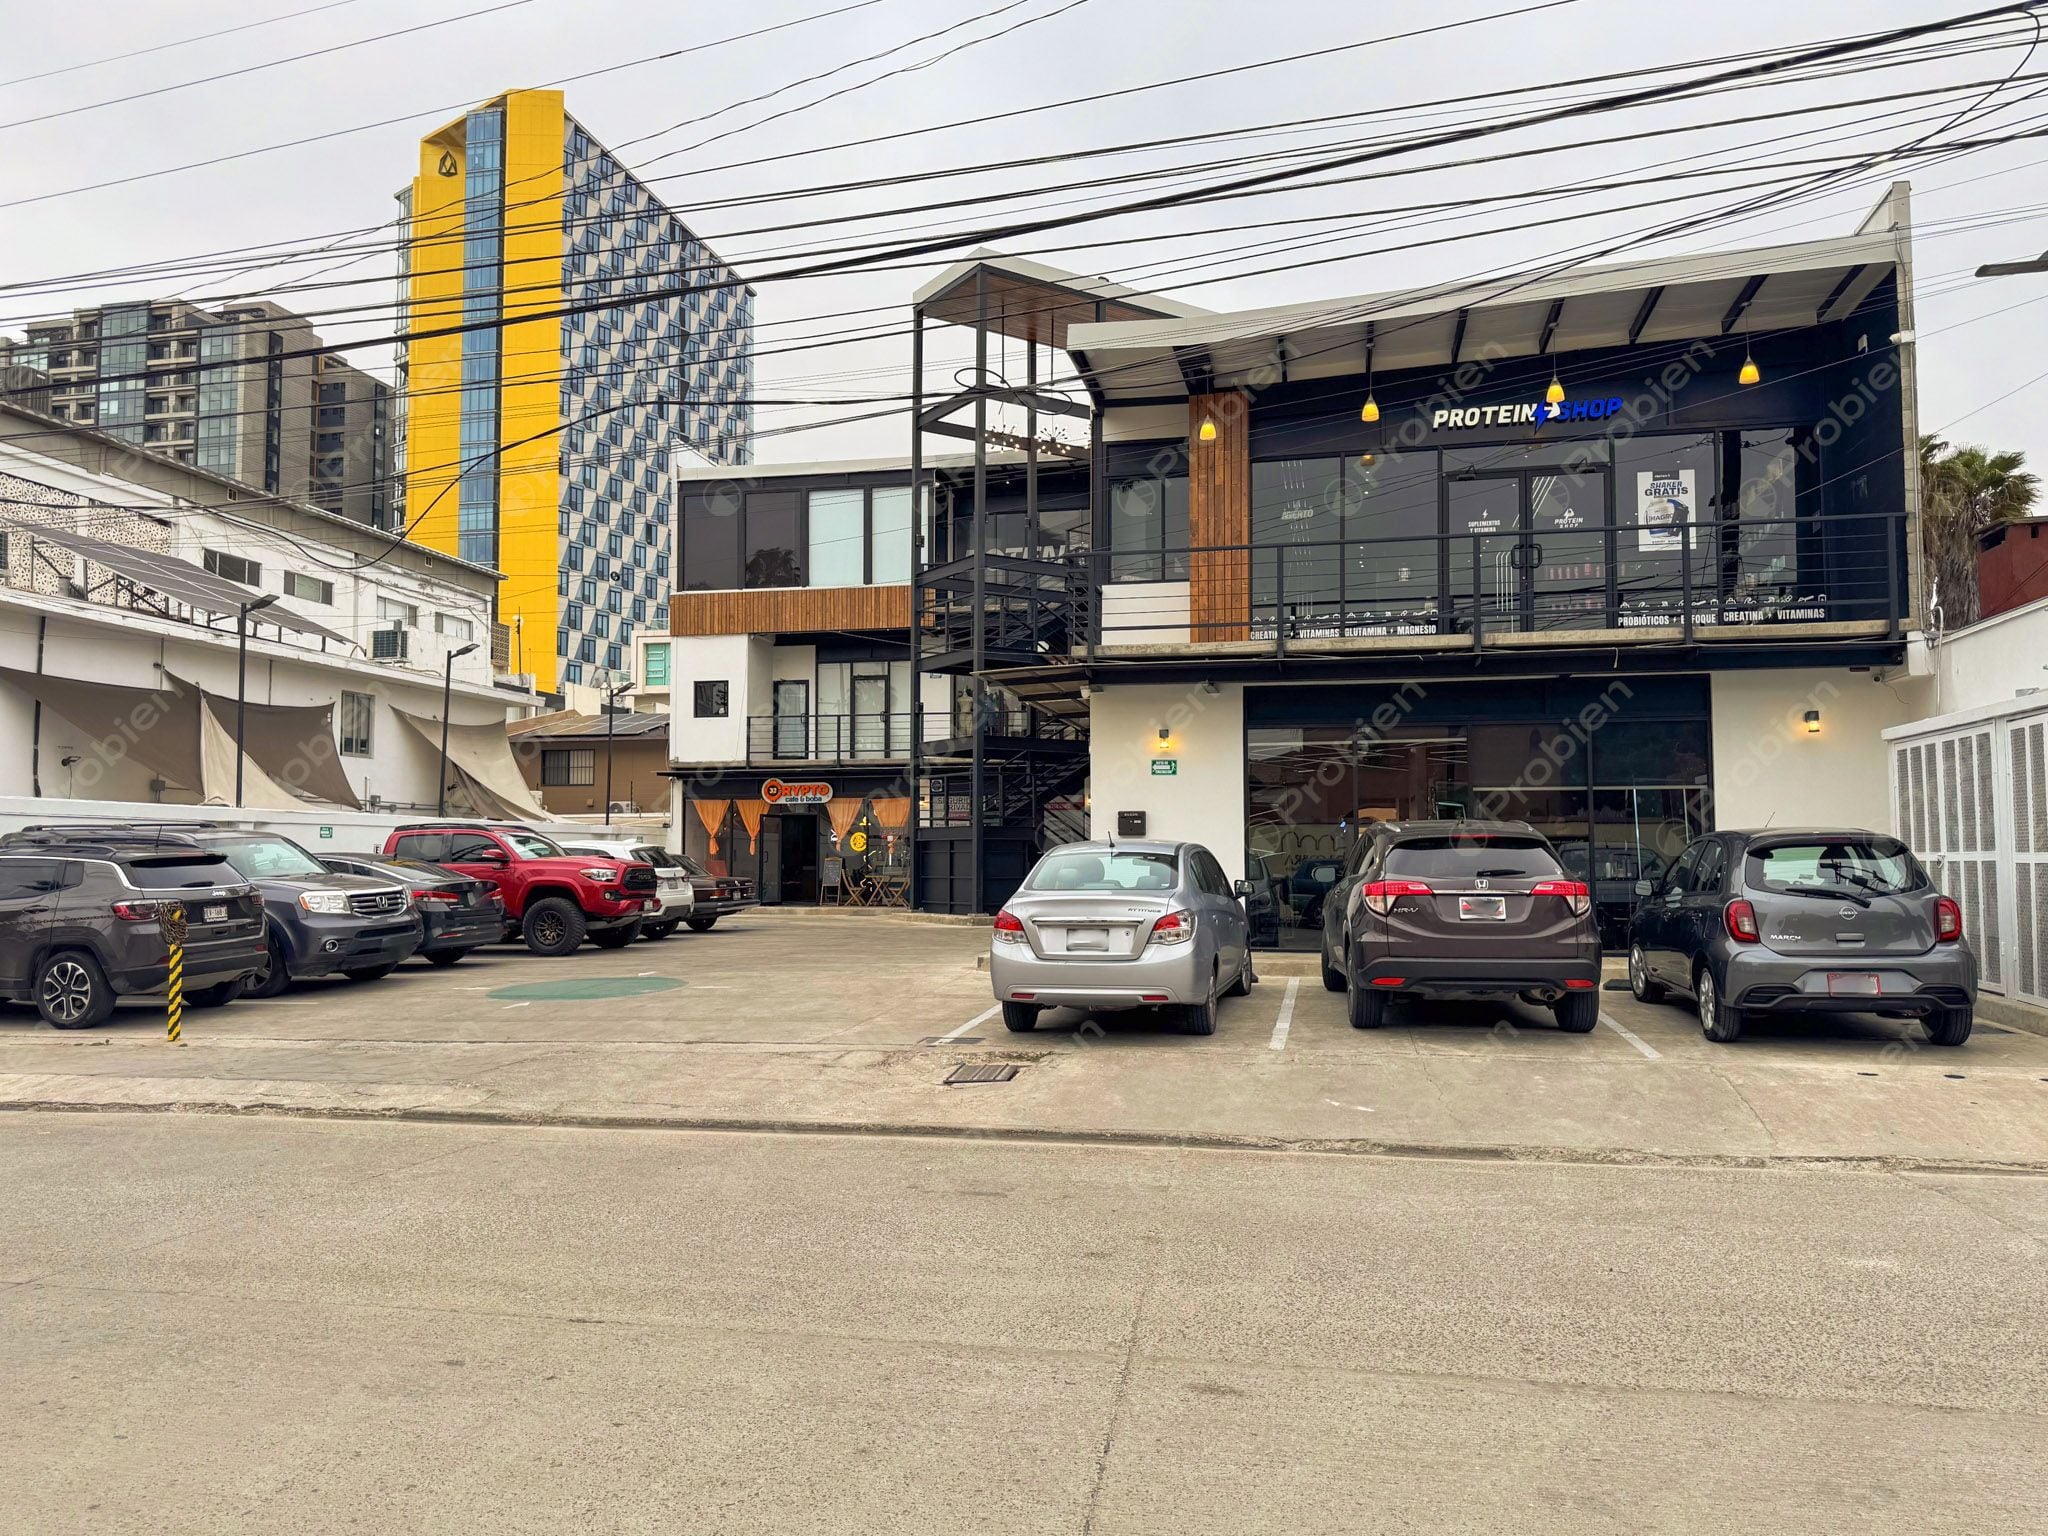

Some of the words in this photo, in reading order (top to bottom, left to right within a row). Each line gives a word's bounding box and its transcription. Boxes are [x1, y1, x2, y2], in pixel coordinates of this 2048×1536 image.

[1432, 403, 1538, 432] PROTEIN
[1558, 397, 1625, 421] SHOP
[1650, 481, 1682, 489] SHAKER
[1644, 487, 1688, 496] GRATIS
[1554, 517, 1584, 525] PROTEIN
[1680, 614, 1717, 625] EFOQUE
[1723, 610, 1764, 622] CREATINA
[1777, 608, 1825, 620] VITAMINAS
[1250, 630, 1278, 640] CREATI
[1299, 626, 1340, 638] VITAMINAS
[1344, 626, 1387, 637] GLUTAMINA
[1397, 624, 1437, 636] MAGNESIO
